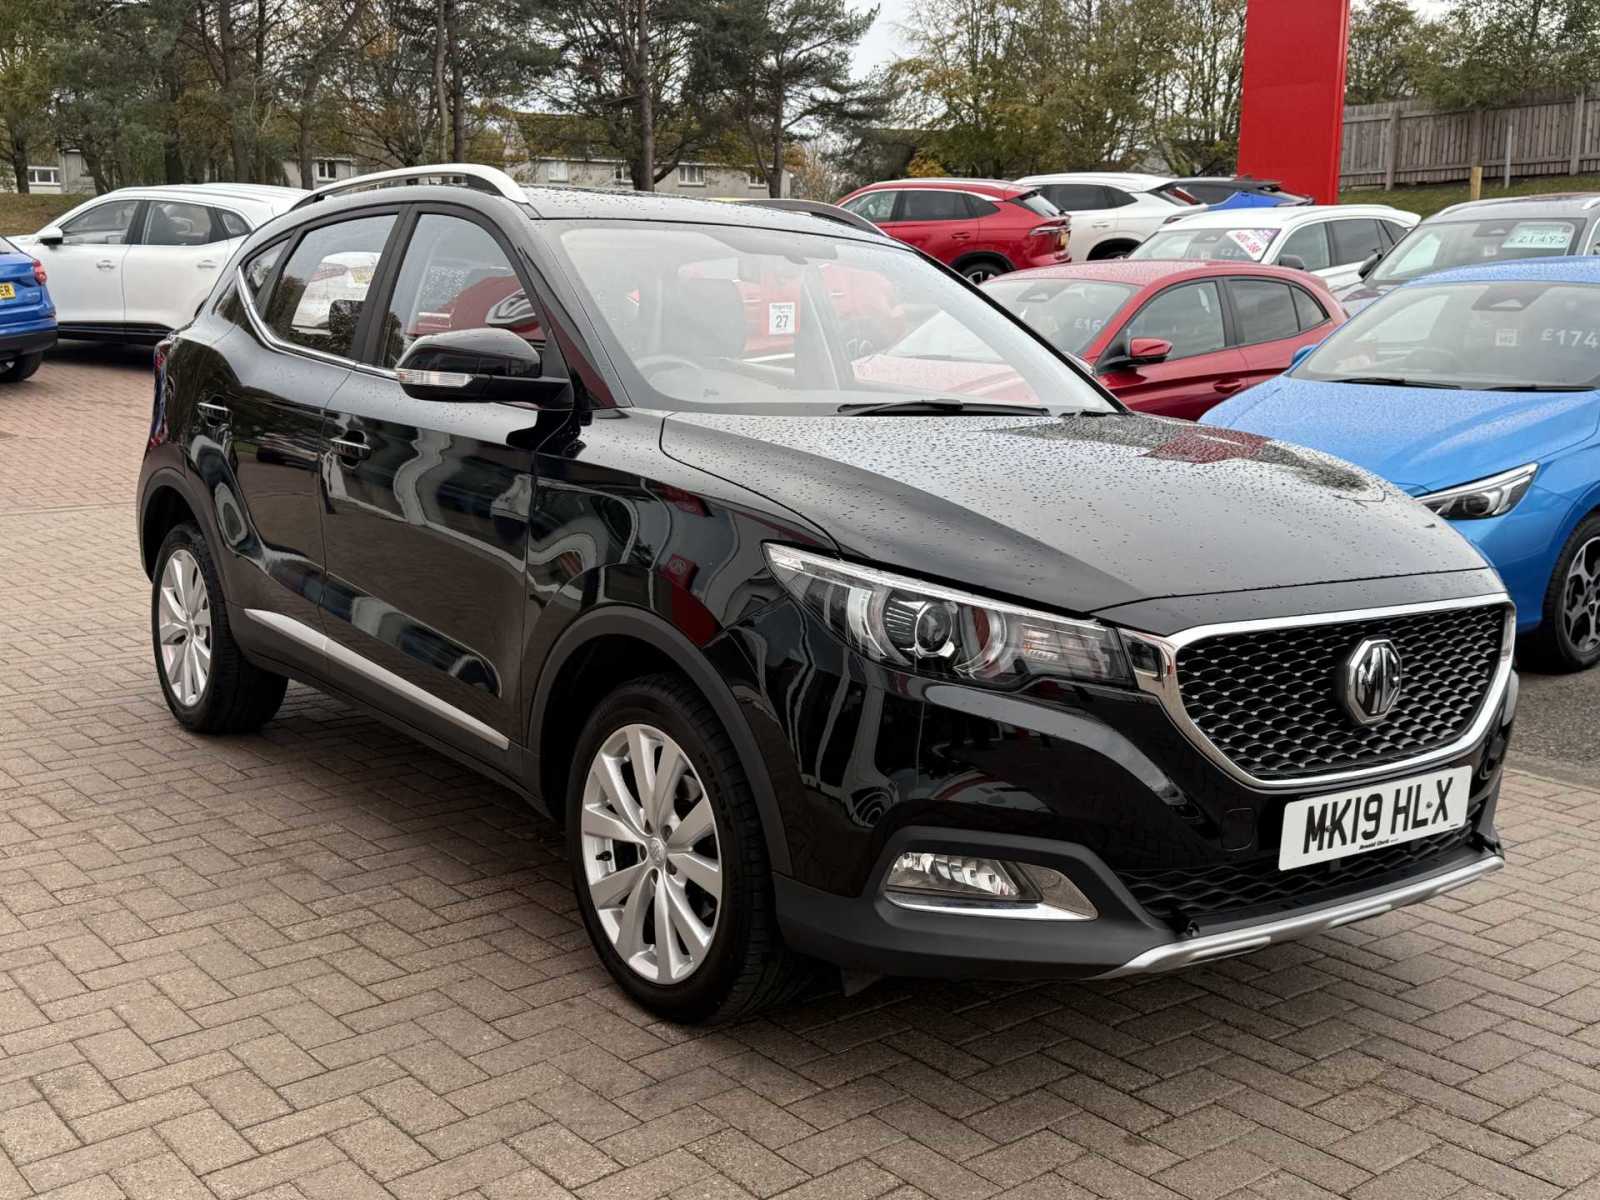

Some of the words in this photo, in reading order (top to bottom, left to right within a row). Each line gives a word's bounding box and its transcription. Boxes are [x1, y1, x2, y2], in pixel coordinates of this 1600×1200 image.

[775, 314, 789, 329] 27
[1541, 328, 1599, 349] £174
[1354, 643, 1399, 716] MG
[1303, 792, 1383, 854] MK19
[1390, 777, 1453, 834] HLX
